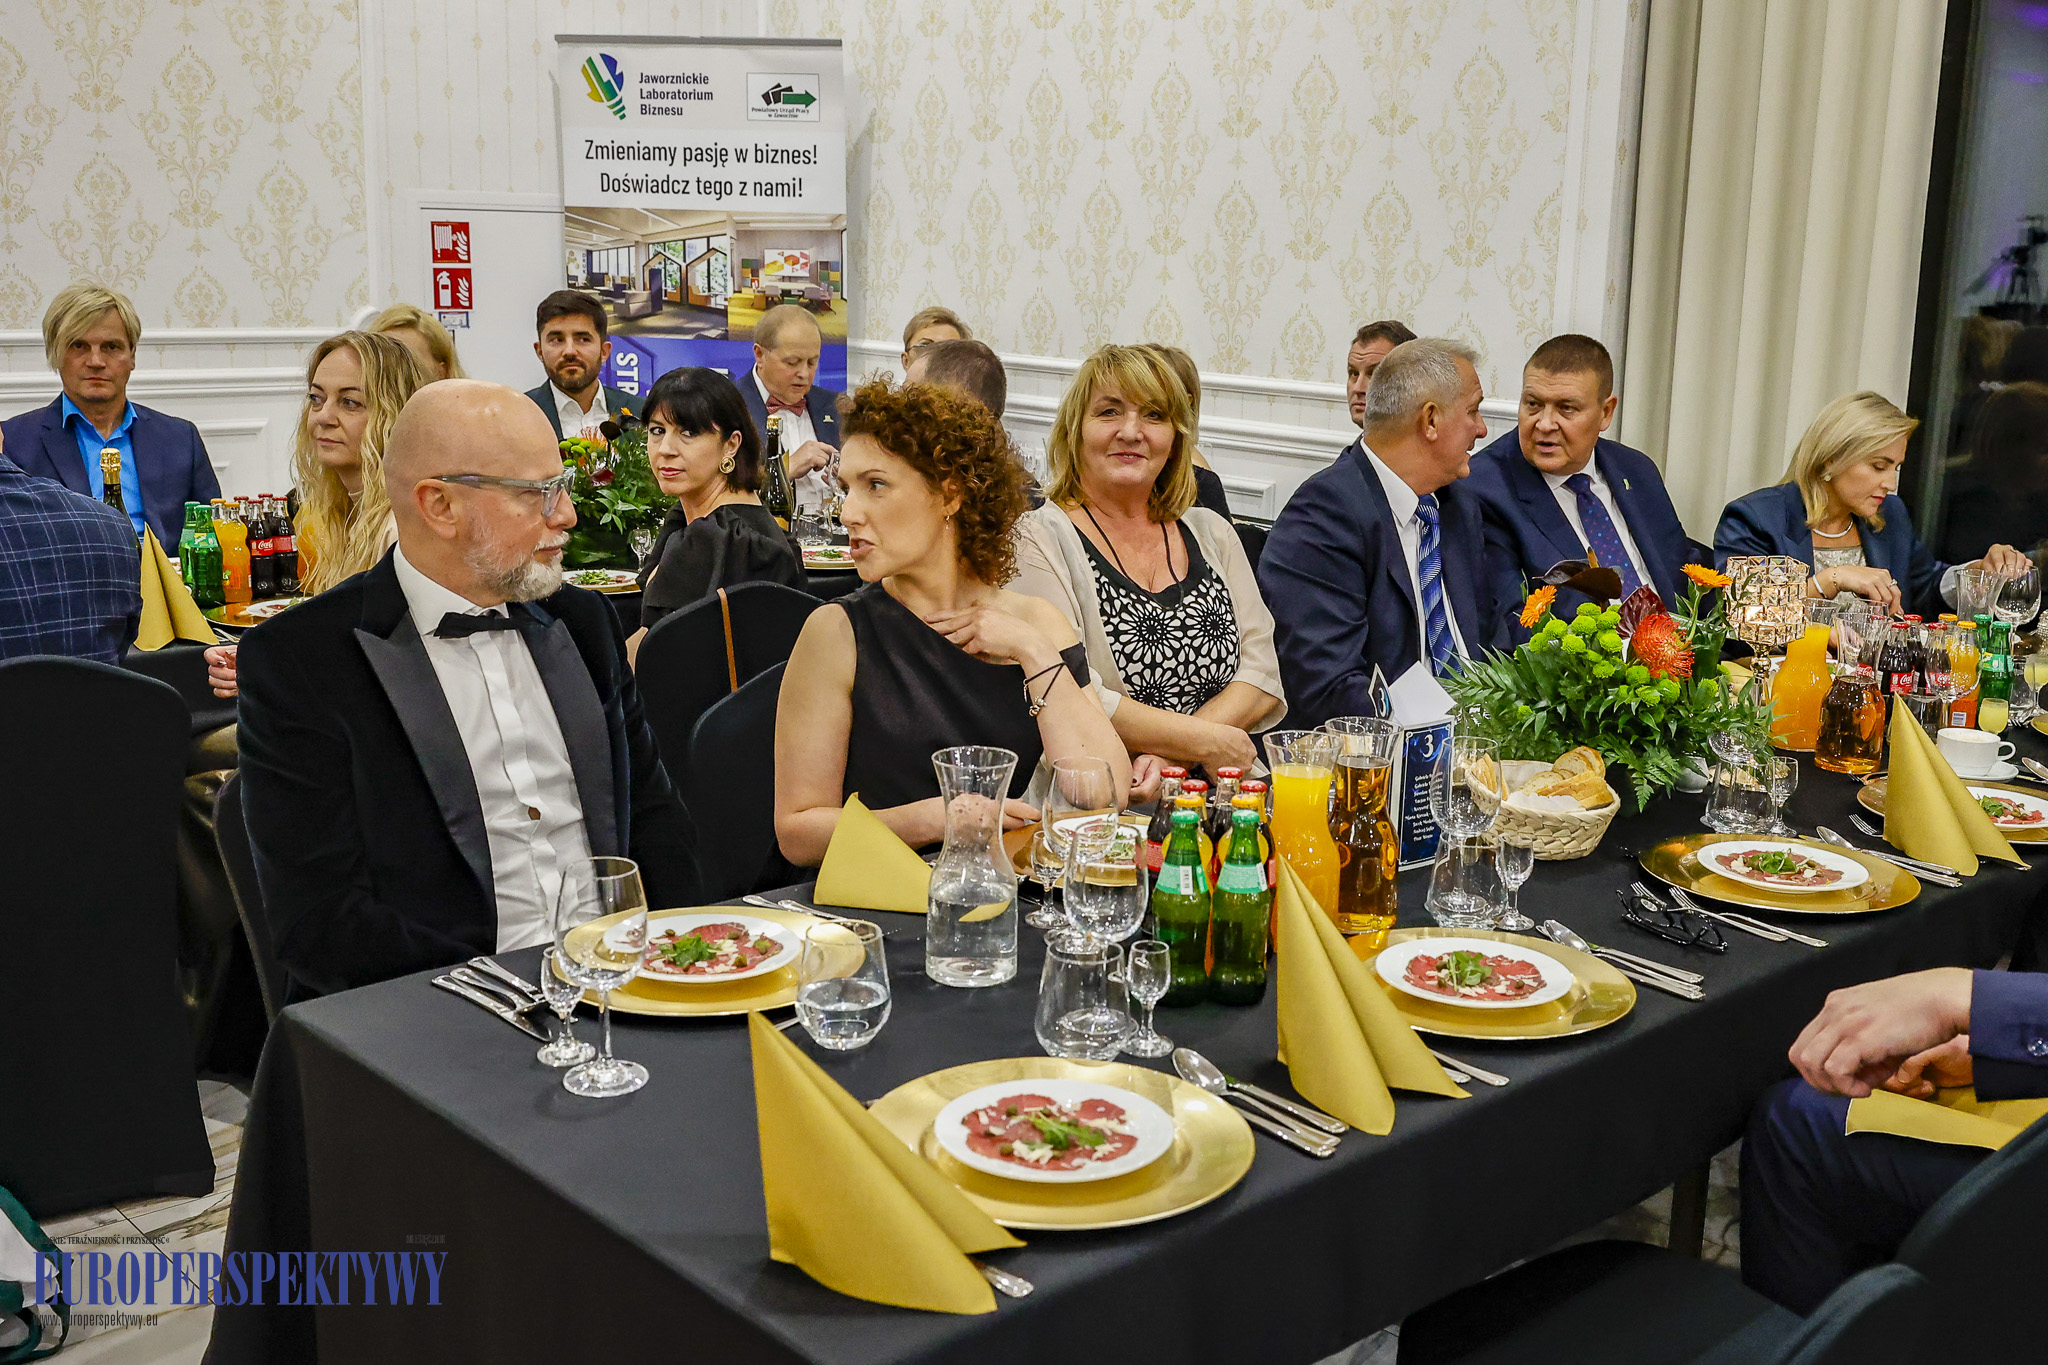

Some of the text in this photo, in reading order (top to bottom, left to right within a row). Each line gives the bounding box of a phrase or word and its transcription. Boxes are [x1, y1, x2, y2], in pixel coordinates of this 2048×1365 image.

[639, 72, 709, 85] Jaworznickie
[640, 88, 713, 101] Laboratorium
[640, 104, 683, 116] Biznesu
[585, 139, 818, 168] Zmieniamy pasję w biznes!
[600, 172, 803, 200] Doświadcz tego z nami!
[1422, 733, 1435, 758] 3
